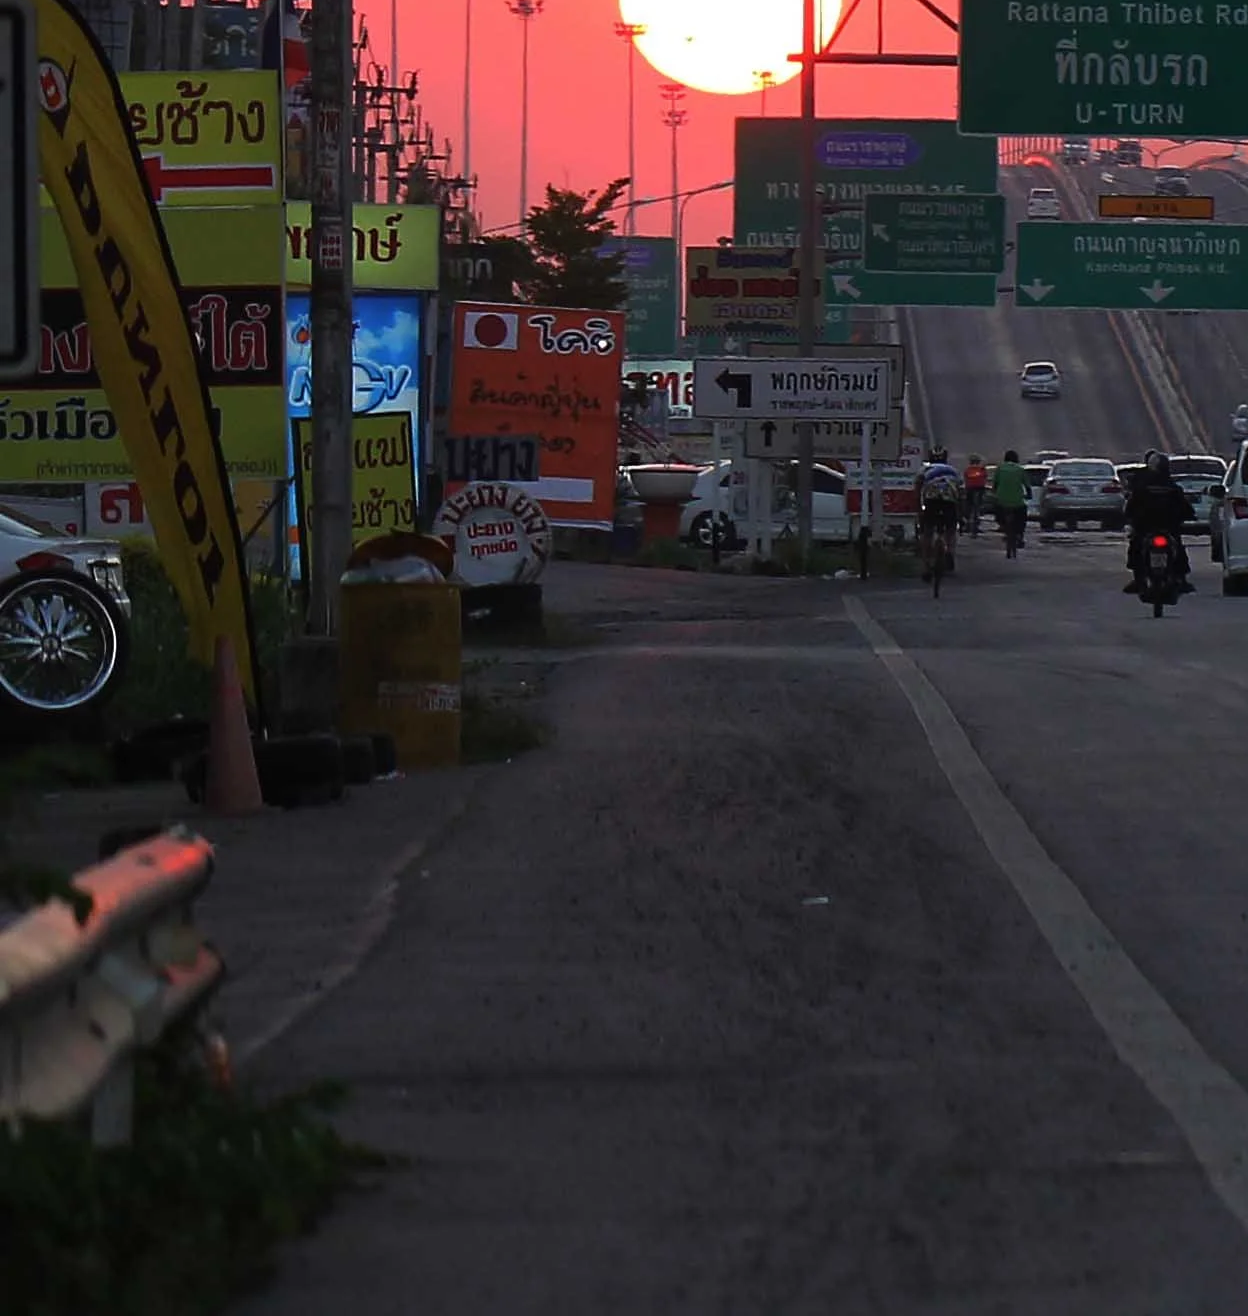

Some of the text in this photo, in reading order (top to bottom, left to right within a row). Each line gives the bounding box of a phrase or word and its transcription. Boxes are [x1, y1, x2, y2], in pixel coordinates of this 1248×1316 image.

[1007, 1, 1109, 24] Rattana
[1054, 29, 1209, 87] ที่กลับรถ
[1075, 102, 1184, 125] U-TURN
[771, 366, 880, 396] พฤกษ์ภิรมย์
